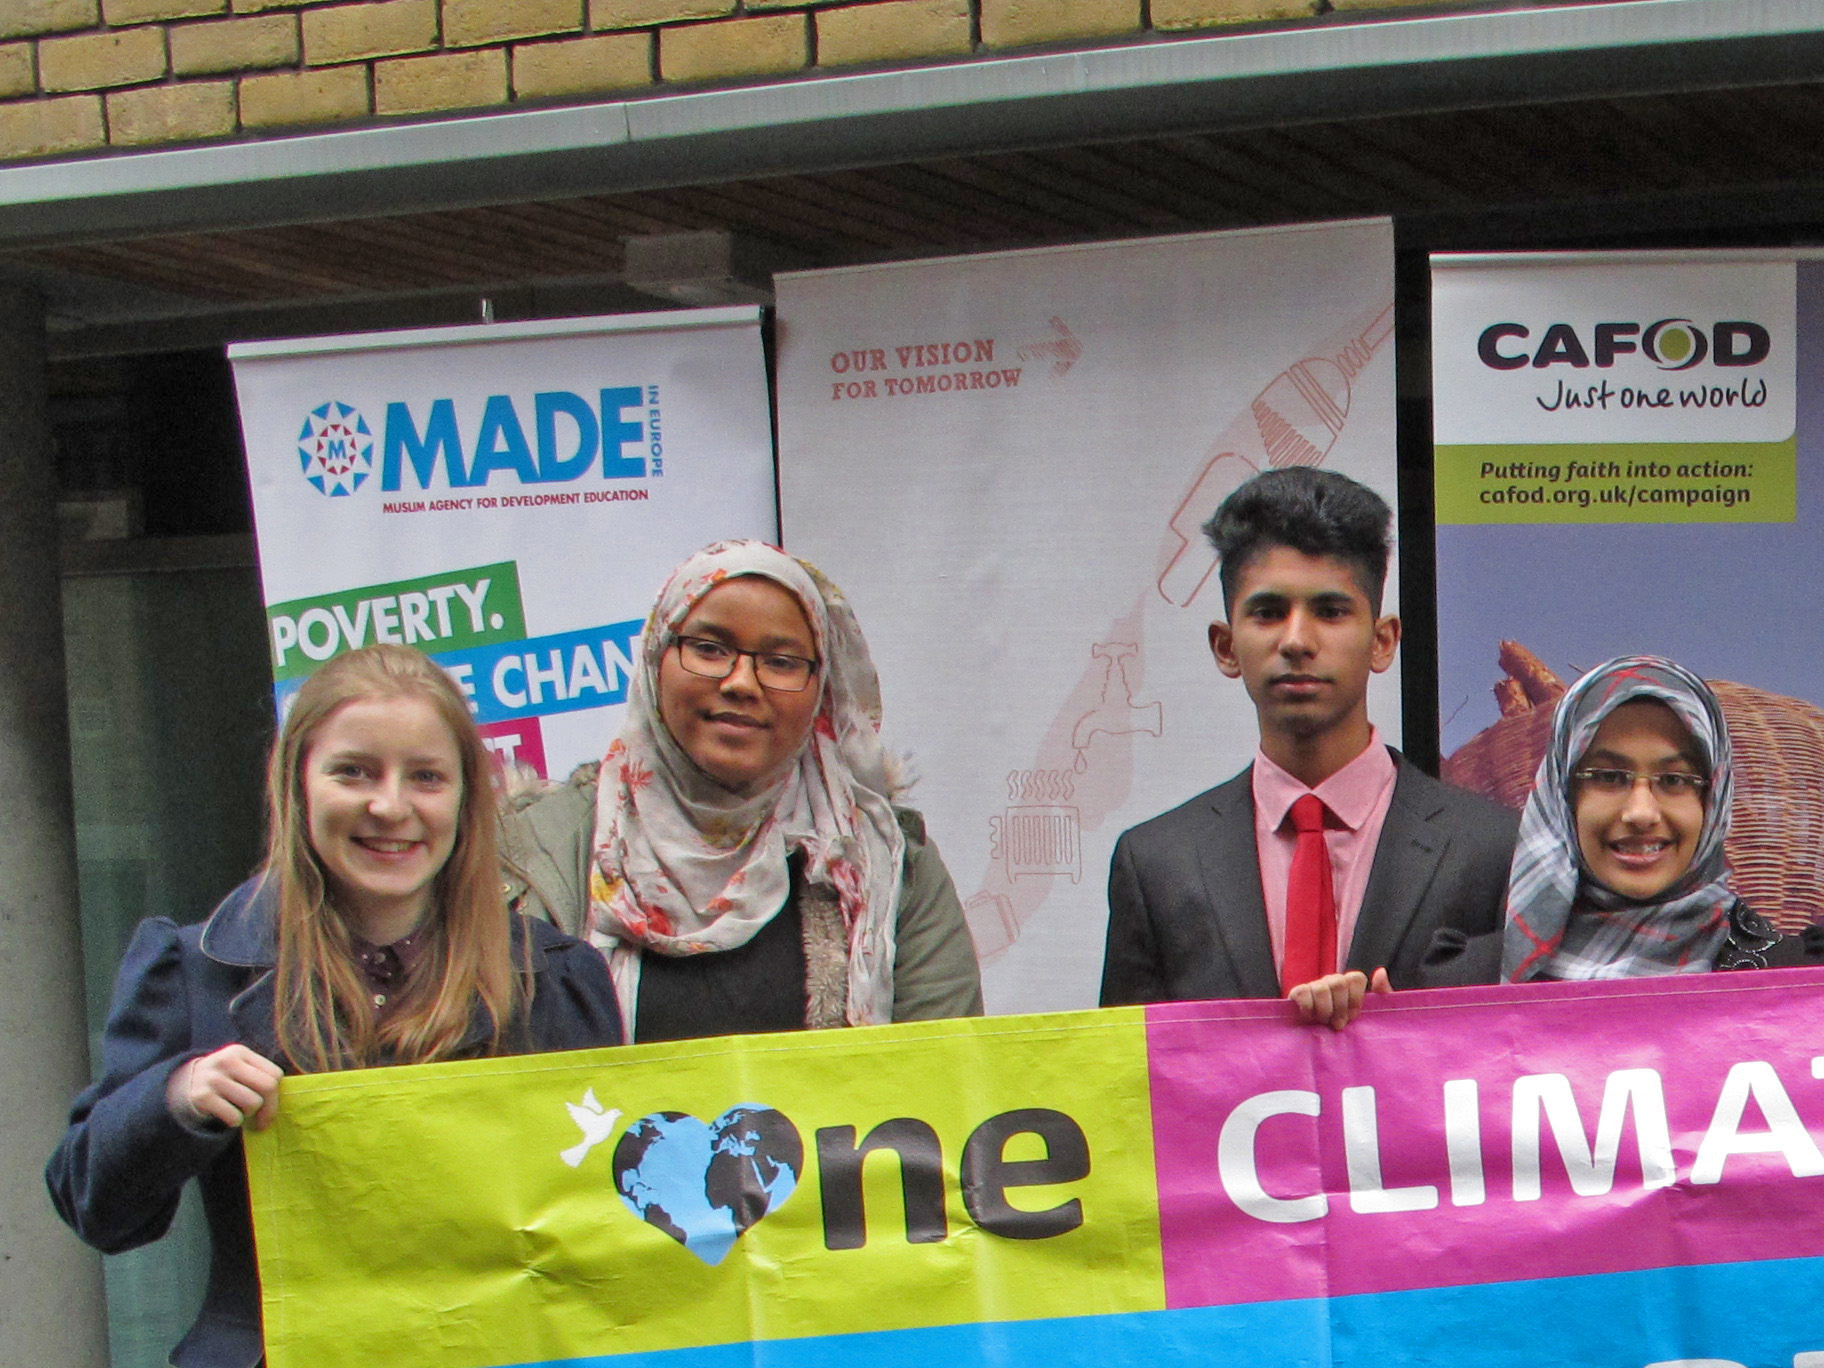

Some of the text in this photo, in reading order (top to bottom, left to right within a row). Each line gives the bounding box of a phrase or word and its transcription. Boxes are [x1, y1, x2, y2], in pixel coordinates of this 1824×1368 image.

[831, 339, 994, 373] OUR VISION
[1477, 318, 1771, 371] CAFOD
[832, 368, 1022, 400] FOR TOMORROW
[381, 386, 647, 491] MADE
[647, 384, 664, 478] IN EUROPE
[1480, 460, 1754, 482] Putting faith into action:
[382, 489, 649, 514] MUSLIM AGENCY FOR DEVELOPMENT EDUCATION
[1479, 485, 1751, 507] cafod.org.uk/campaign
[272, 579, 504, 667] POVERTY.
